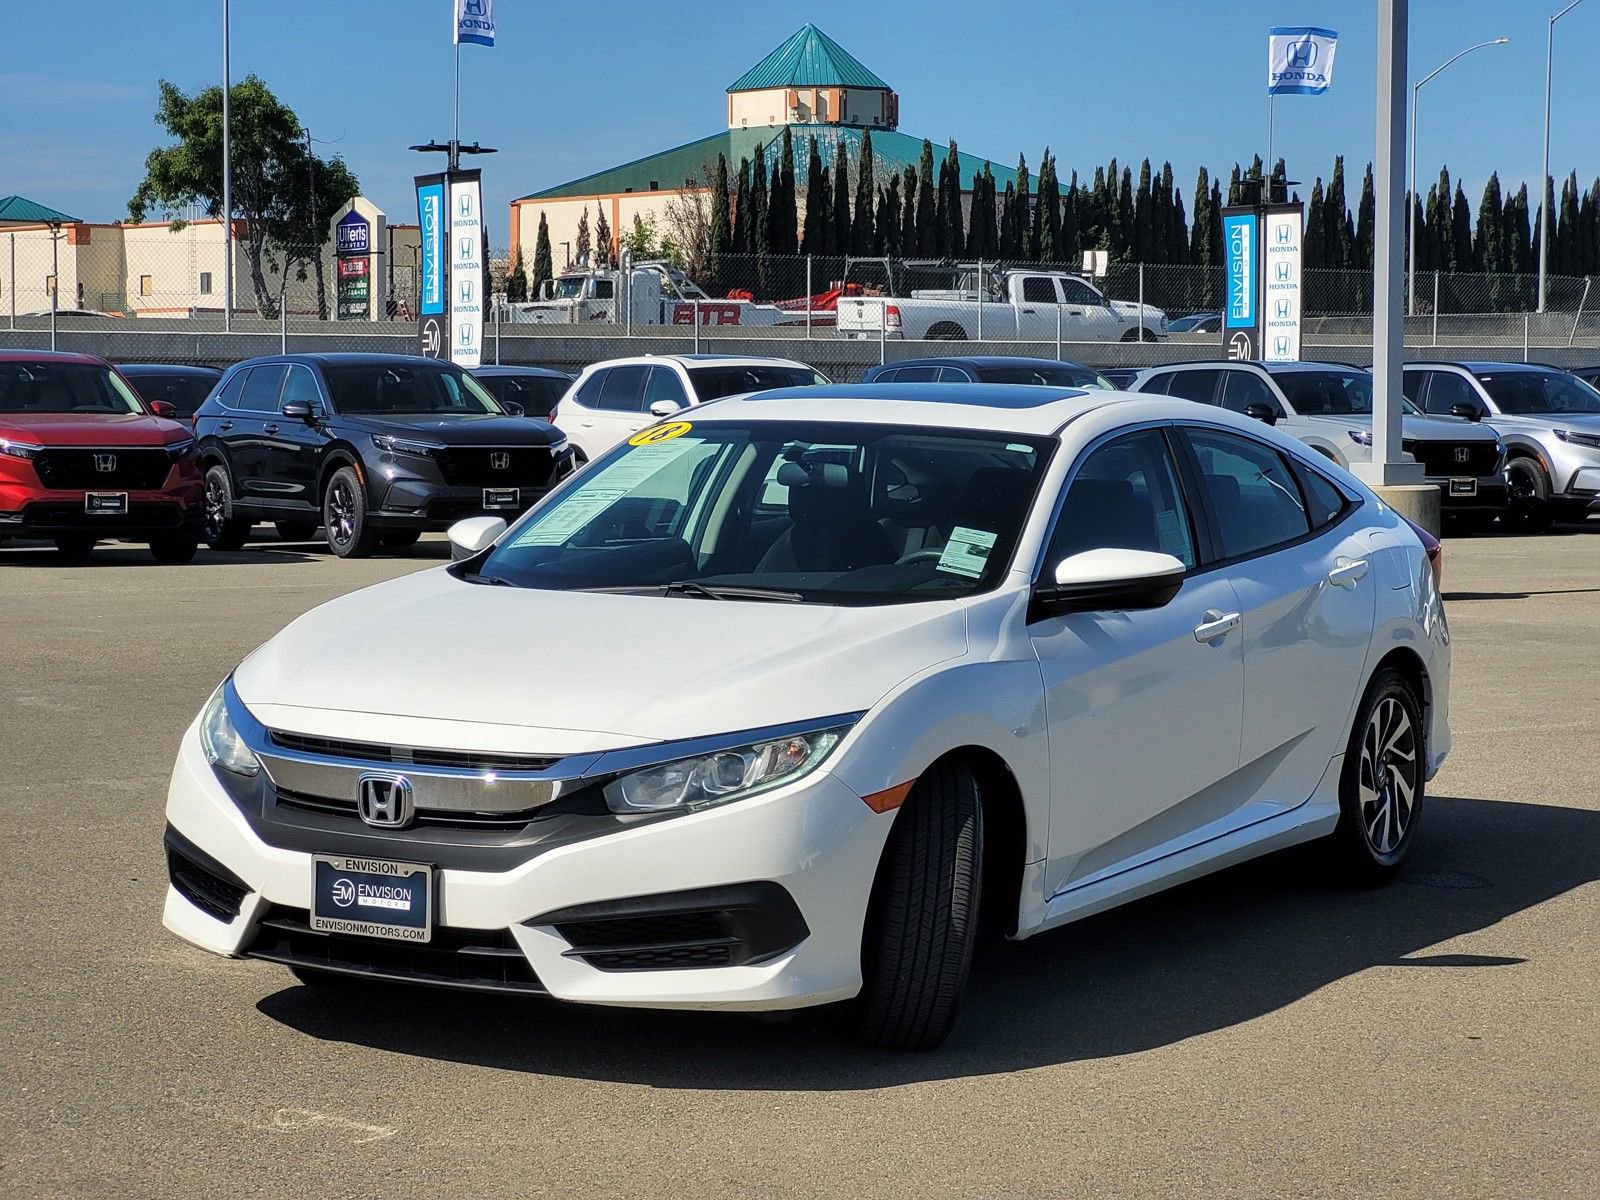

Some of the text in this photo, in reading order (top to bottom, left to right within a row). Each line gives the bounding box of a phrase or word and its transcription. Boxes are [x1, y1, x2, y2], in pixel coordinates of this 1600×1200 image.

[1271, 72, 1327, 82] HONDA
[454, 219, 479, 227] HONDA
[423, 195, 434, 304] ENVISION
[454, 262, 480, 270] HONDA
[1230, 225, 1243, 318] ENVISION
[454, 305, 480, 313] HONDA
[454, 348, 479, 356] HONDA
[345, 859, 398, 875] ENVISION
[357, 884, 412, 901] ENVISION
[362, 899, 406, 908] MOTORS
[315, 919, 425, 940] ENVISIONMOTORS.COM
